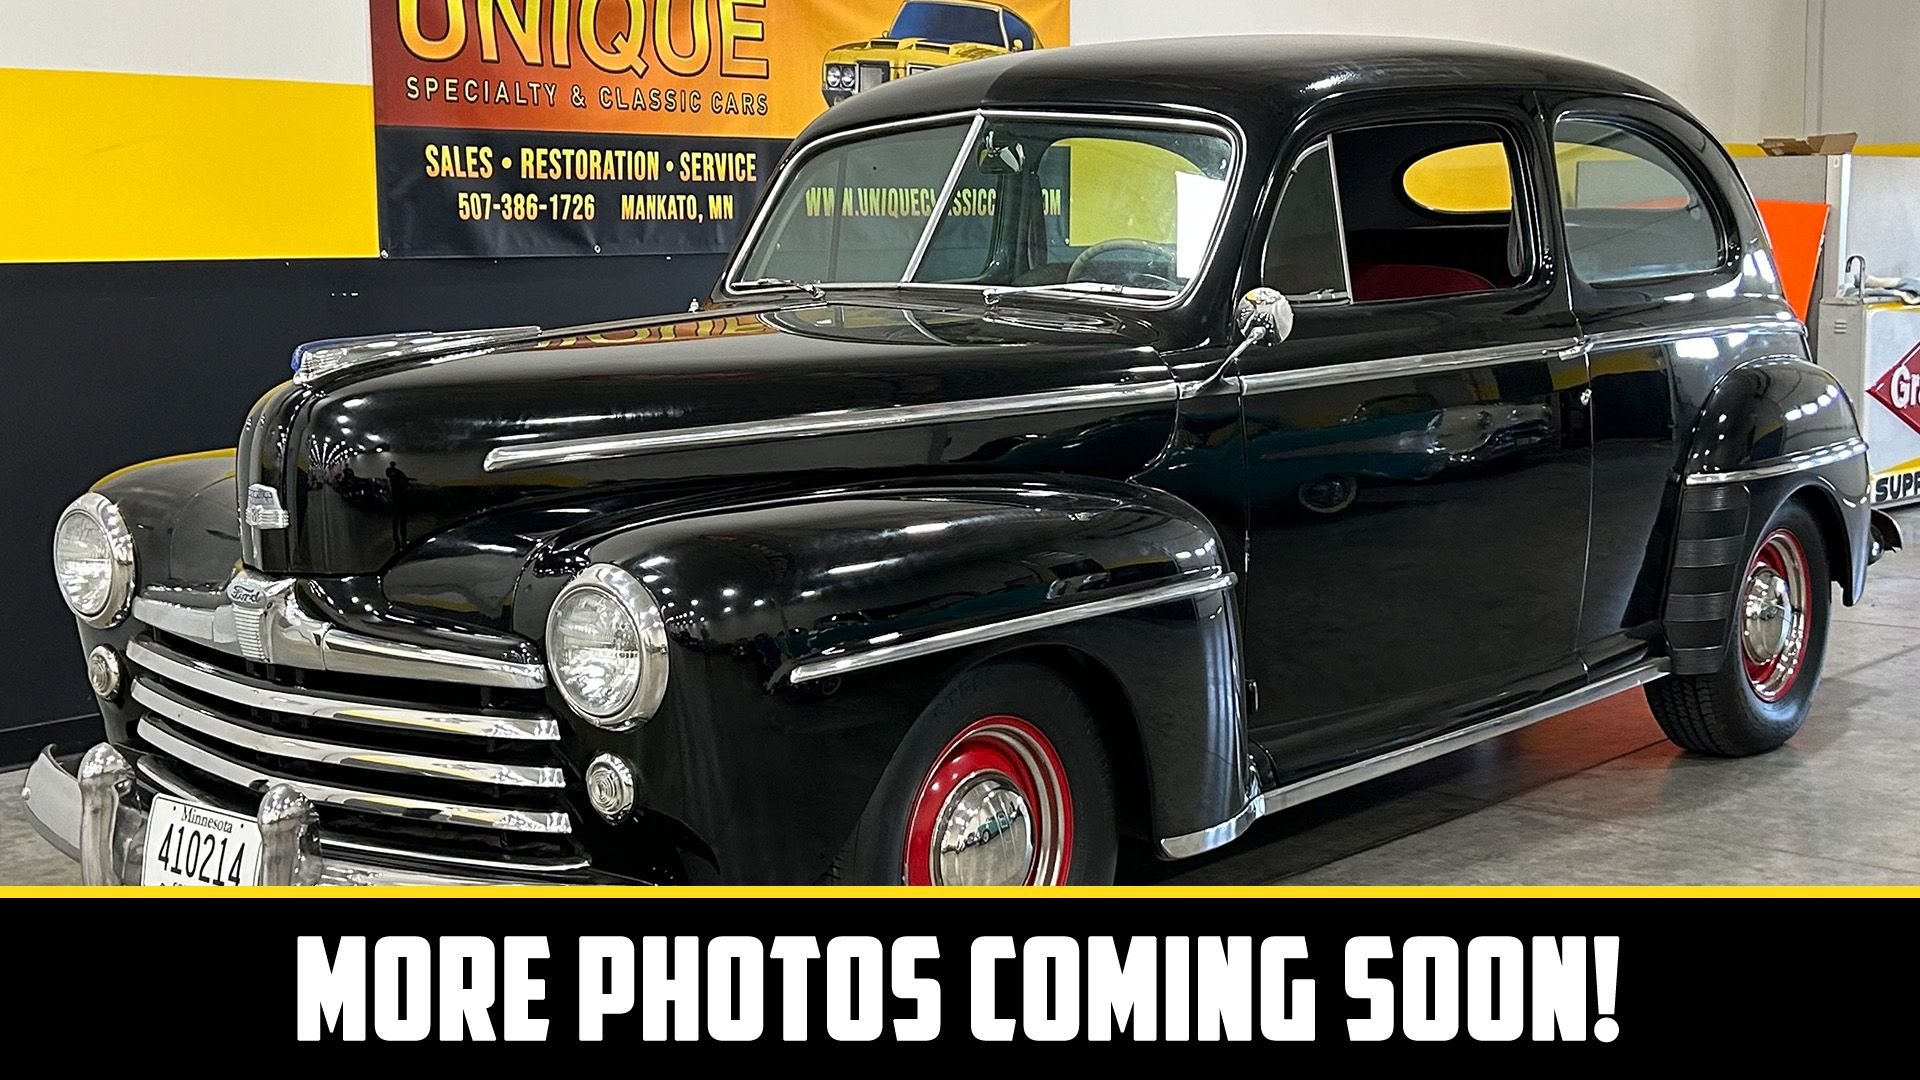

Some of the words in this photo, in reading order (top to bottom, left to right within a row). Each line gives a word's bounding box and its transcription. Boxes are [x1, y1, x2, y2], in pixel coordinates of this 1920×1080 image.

[398, 0, 770, 79] UNIQUE
[405, 76, 558, 107] SPECIALTY
[570, 85, 587, 108] &
[599, 86, 702, 112] CLASSIC
[710, 92, 769, 115] CARS
[424, 143, 494, 179] SALES
[520, 147, 660, 181] RESTORATION
[678, 151, 757, 182] SERVICE
[457, 192, 596, 220] 507-386-1726
[620, 194, 704, 223] MANKATO,
[708, 195, 734, 220] MN
[1890, 364, 1920, 410] Gr
[231, 585, 261, 603] Ford
[180, 804, 234, 834] Minnesota
[157, 823, 246, 886] 410214
